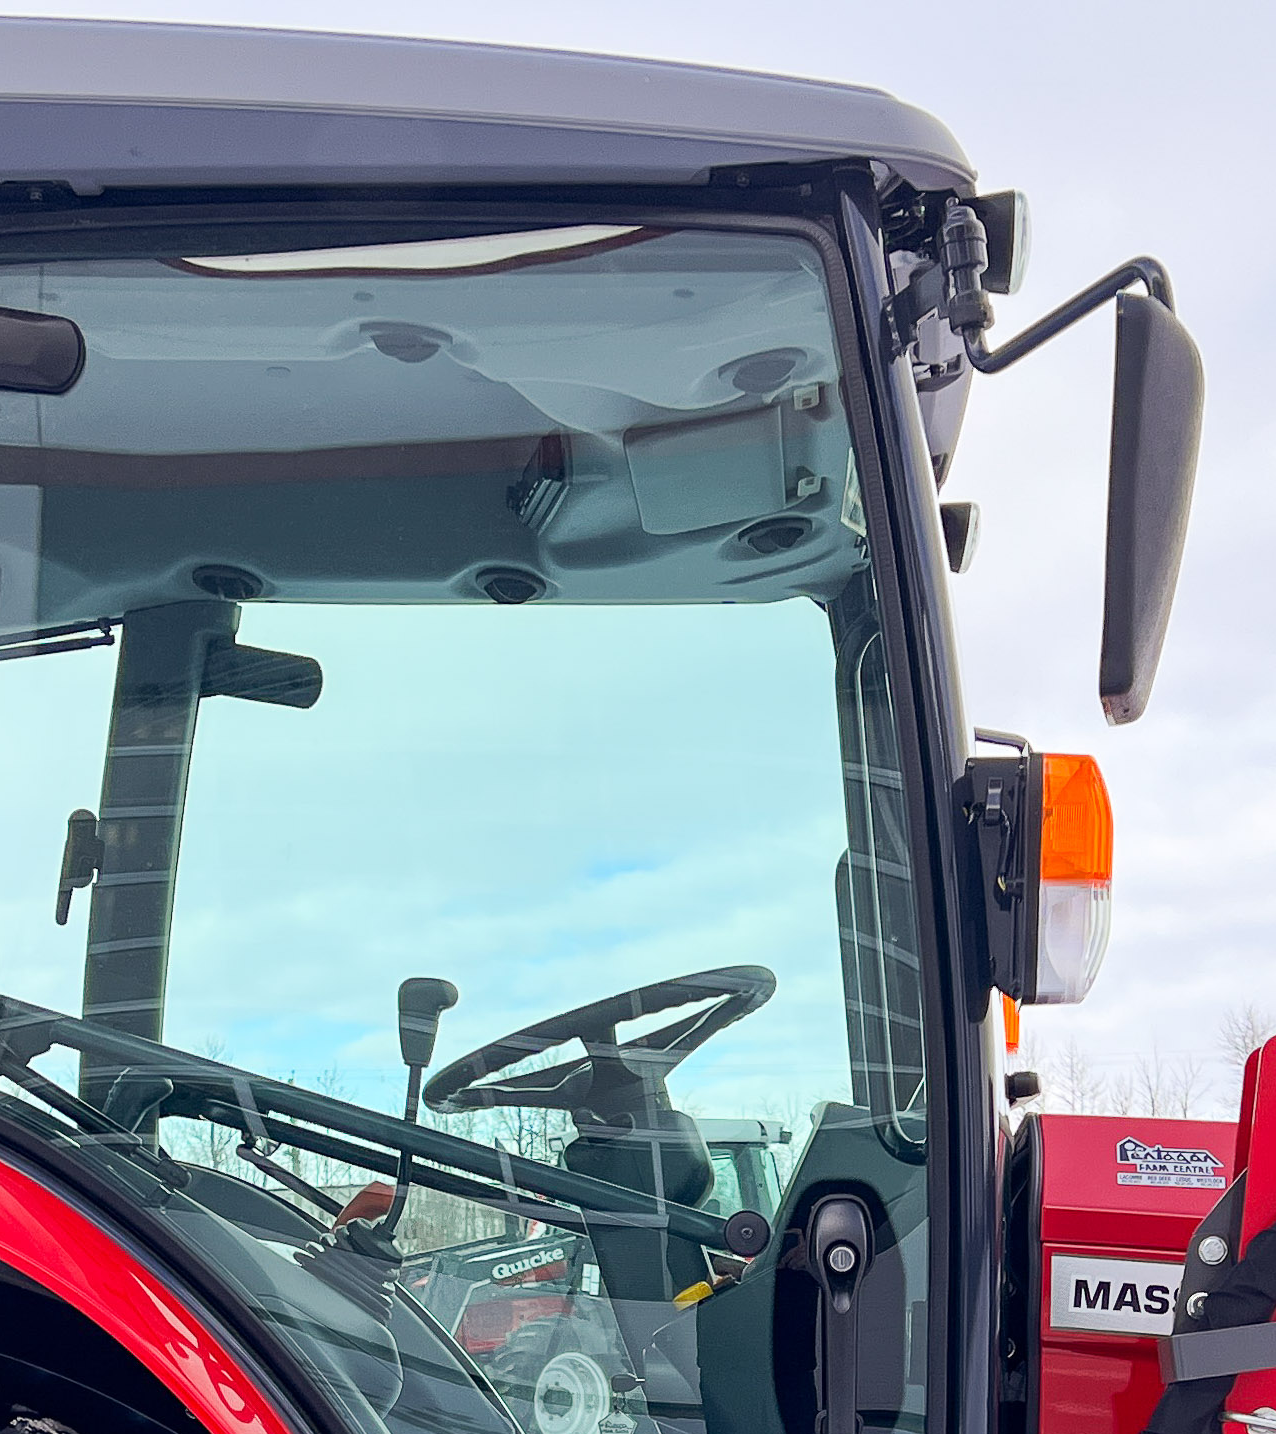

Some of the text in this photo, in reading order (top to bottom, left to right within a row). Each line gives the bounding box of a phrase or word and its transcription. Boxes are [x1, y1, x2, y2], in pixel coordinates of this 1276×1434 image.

[1139, 1163, 1213, 1174] FARM CENTRE
[491, 1247, 565, 1280] Quicke
[1073, 1278, 1180, 1315] MAS
